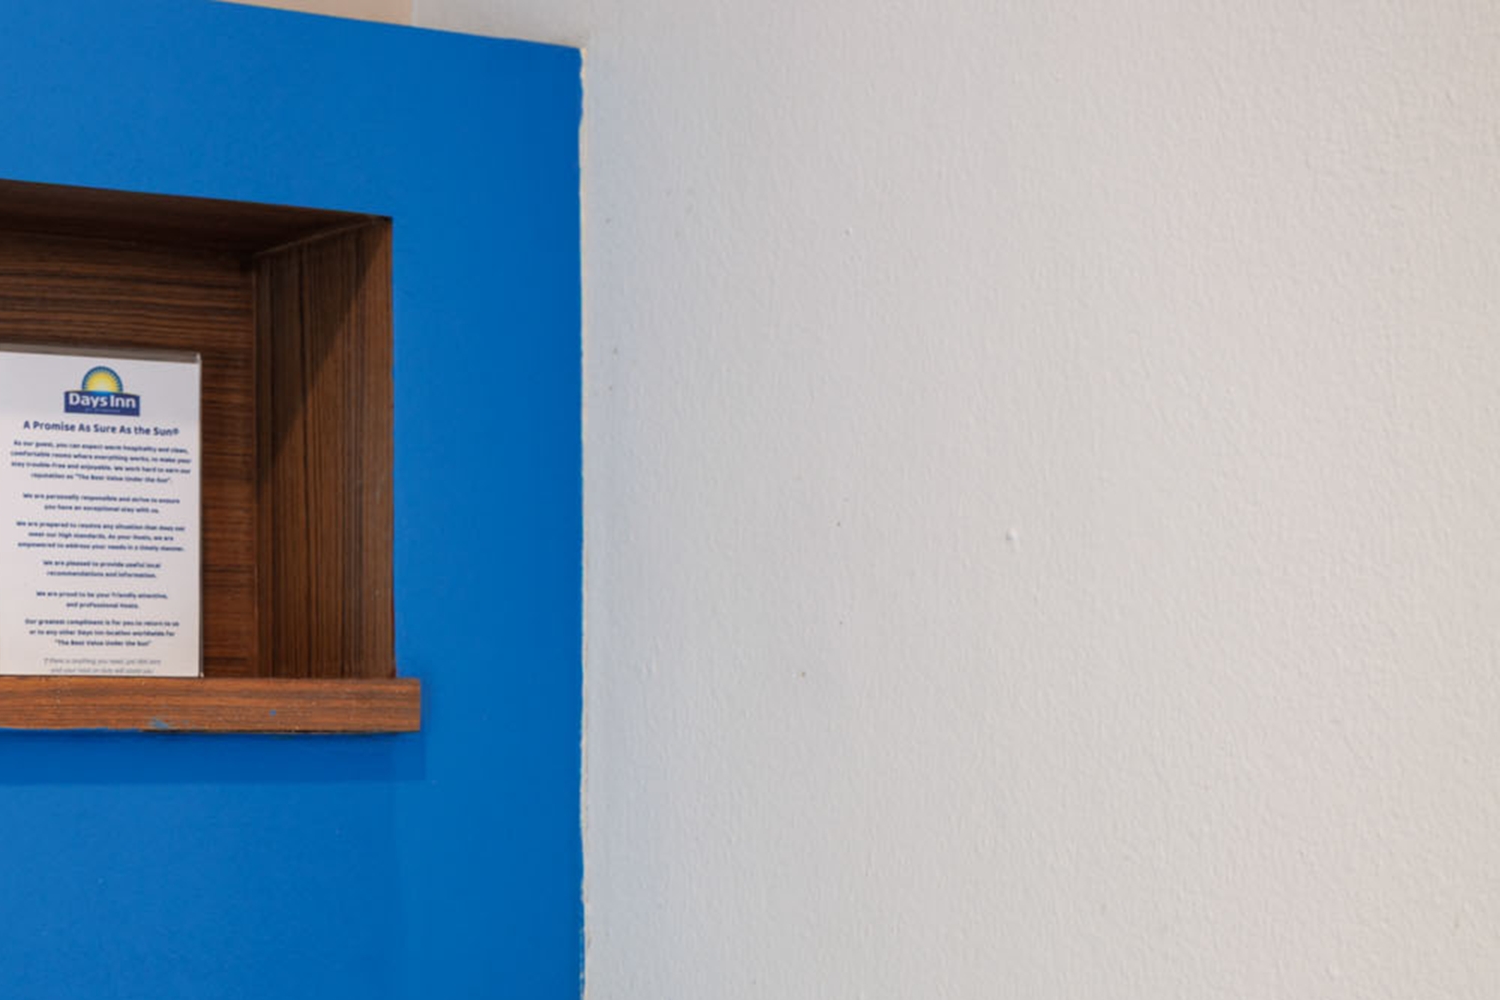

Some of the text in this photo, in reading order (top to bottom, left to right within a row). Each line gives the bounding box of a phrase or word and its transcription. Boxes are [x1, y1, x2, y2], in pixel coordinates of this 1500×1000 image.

[68, 392, 136, 408] Days Inn
[23, 420, 30, 429] A
[32, 420, 76, 432] Promise
[78, 423, 91, 432] As
[93, 423, 117, 433] Sure
[119, 425, 131, 434] As
[133, 426, 151, 435] the
